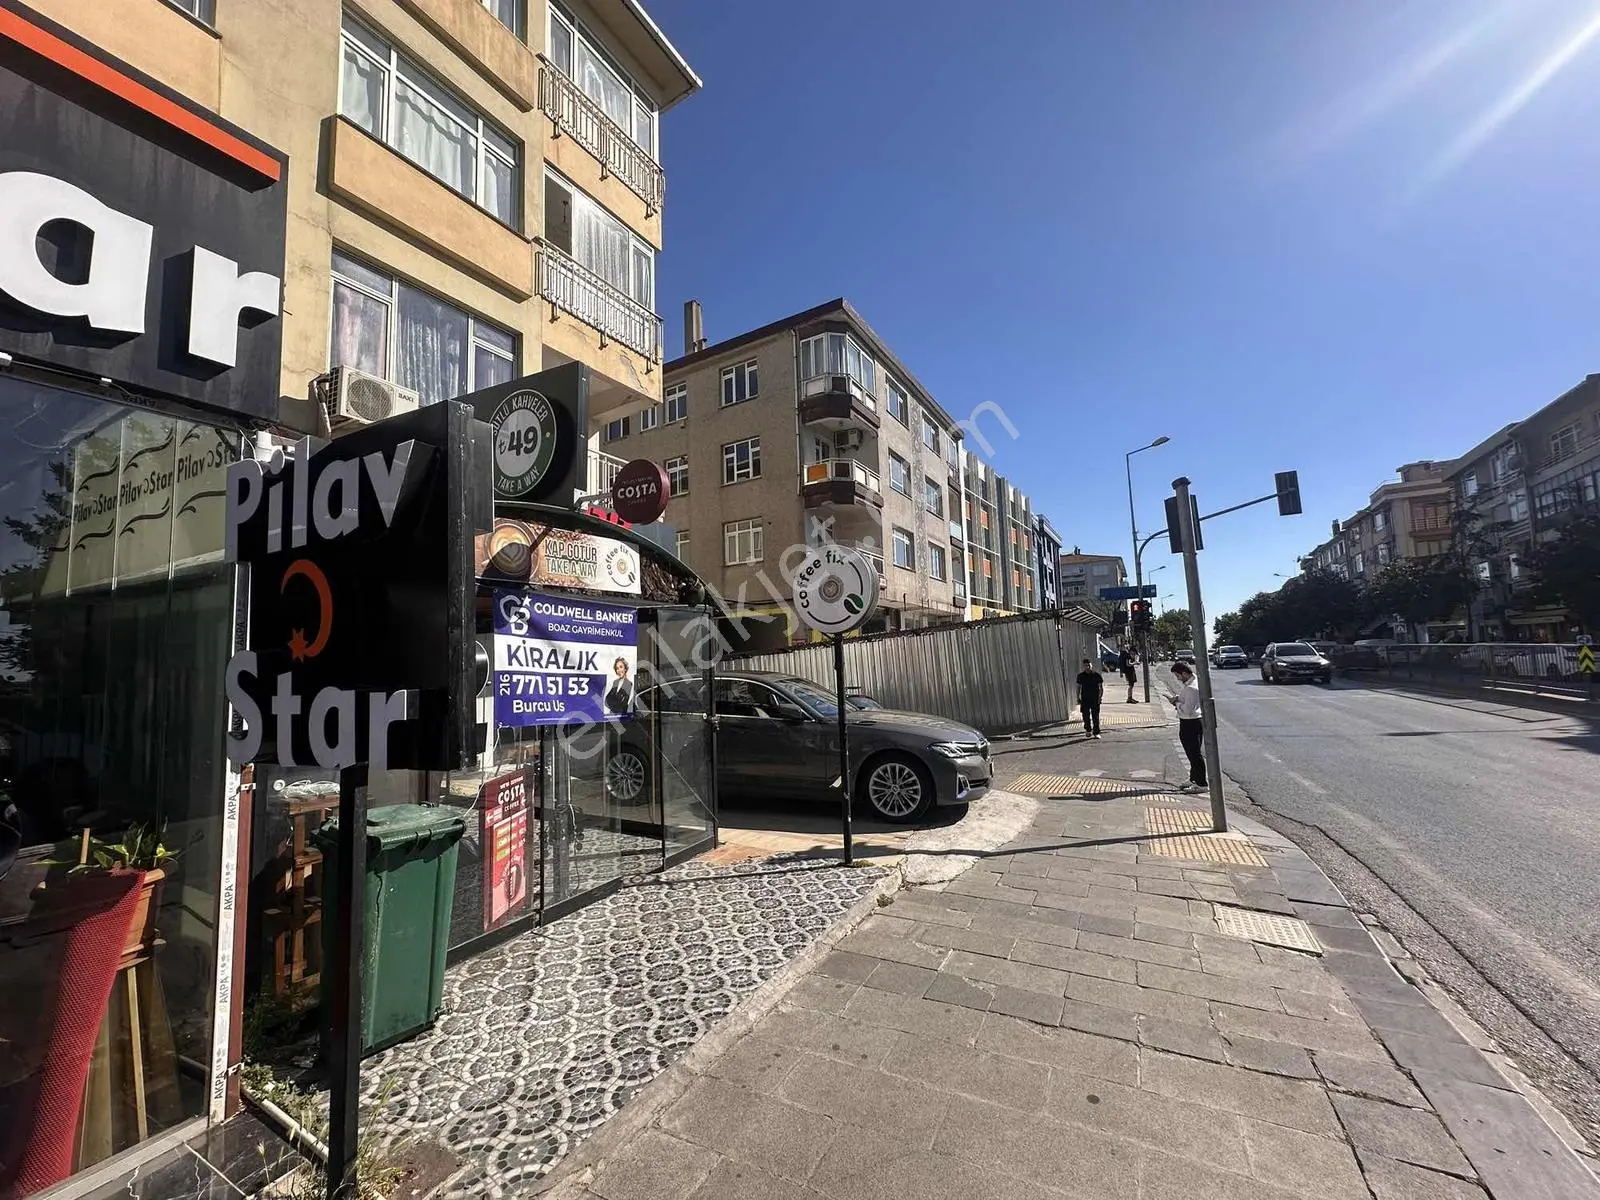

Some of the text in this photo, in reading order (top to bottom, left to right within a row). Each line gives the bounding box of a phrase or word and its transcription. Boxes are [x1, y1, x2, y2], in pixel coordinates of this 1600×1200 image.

[512, 394, 549, 422] KAHVELER
[176, 452, 206, 484] Pilav
[497, 465, 540, 493] TAKE A WAY
[119, 470, 173, 506] Pilav Star
[223, 436, 416, 564] Pilav
[617, 482, 657, 499] COSTA
[73, 504, 93, 524] Pilav
[98, 493, 117, 516] Star
[545, 538, 597, 561] KAP GÖTÜR
[605, 545, 629, 576] coffee fix
[545, 556, 598, 577] TAKE A WAY
[799, 550, 847, 609] coffee fix
[534, 602, 634, 624] COLDWELL BANKER
[548, 622, 624, 638] BOAZ GAYRİMENKUL
[506, 639, 599, 672] KİRALIK
[499, 673, 511, 696] 216
[512, 674, 590, 696] 771 51 53
[225, 650, 408, 772] Star
[512, 699, 565, 714] Burcu Us
[227, 795, 237, 821] AKPA
[498, 783, 525, 806] COSTA
[223, 883, 234, 911] AKPA
[219, 975, 230, 1004] AKPA
[214, 1070, 226, 1100] AKPA
